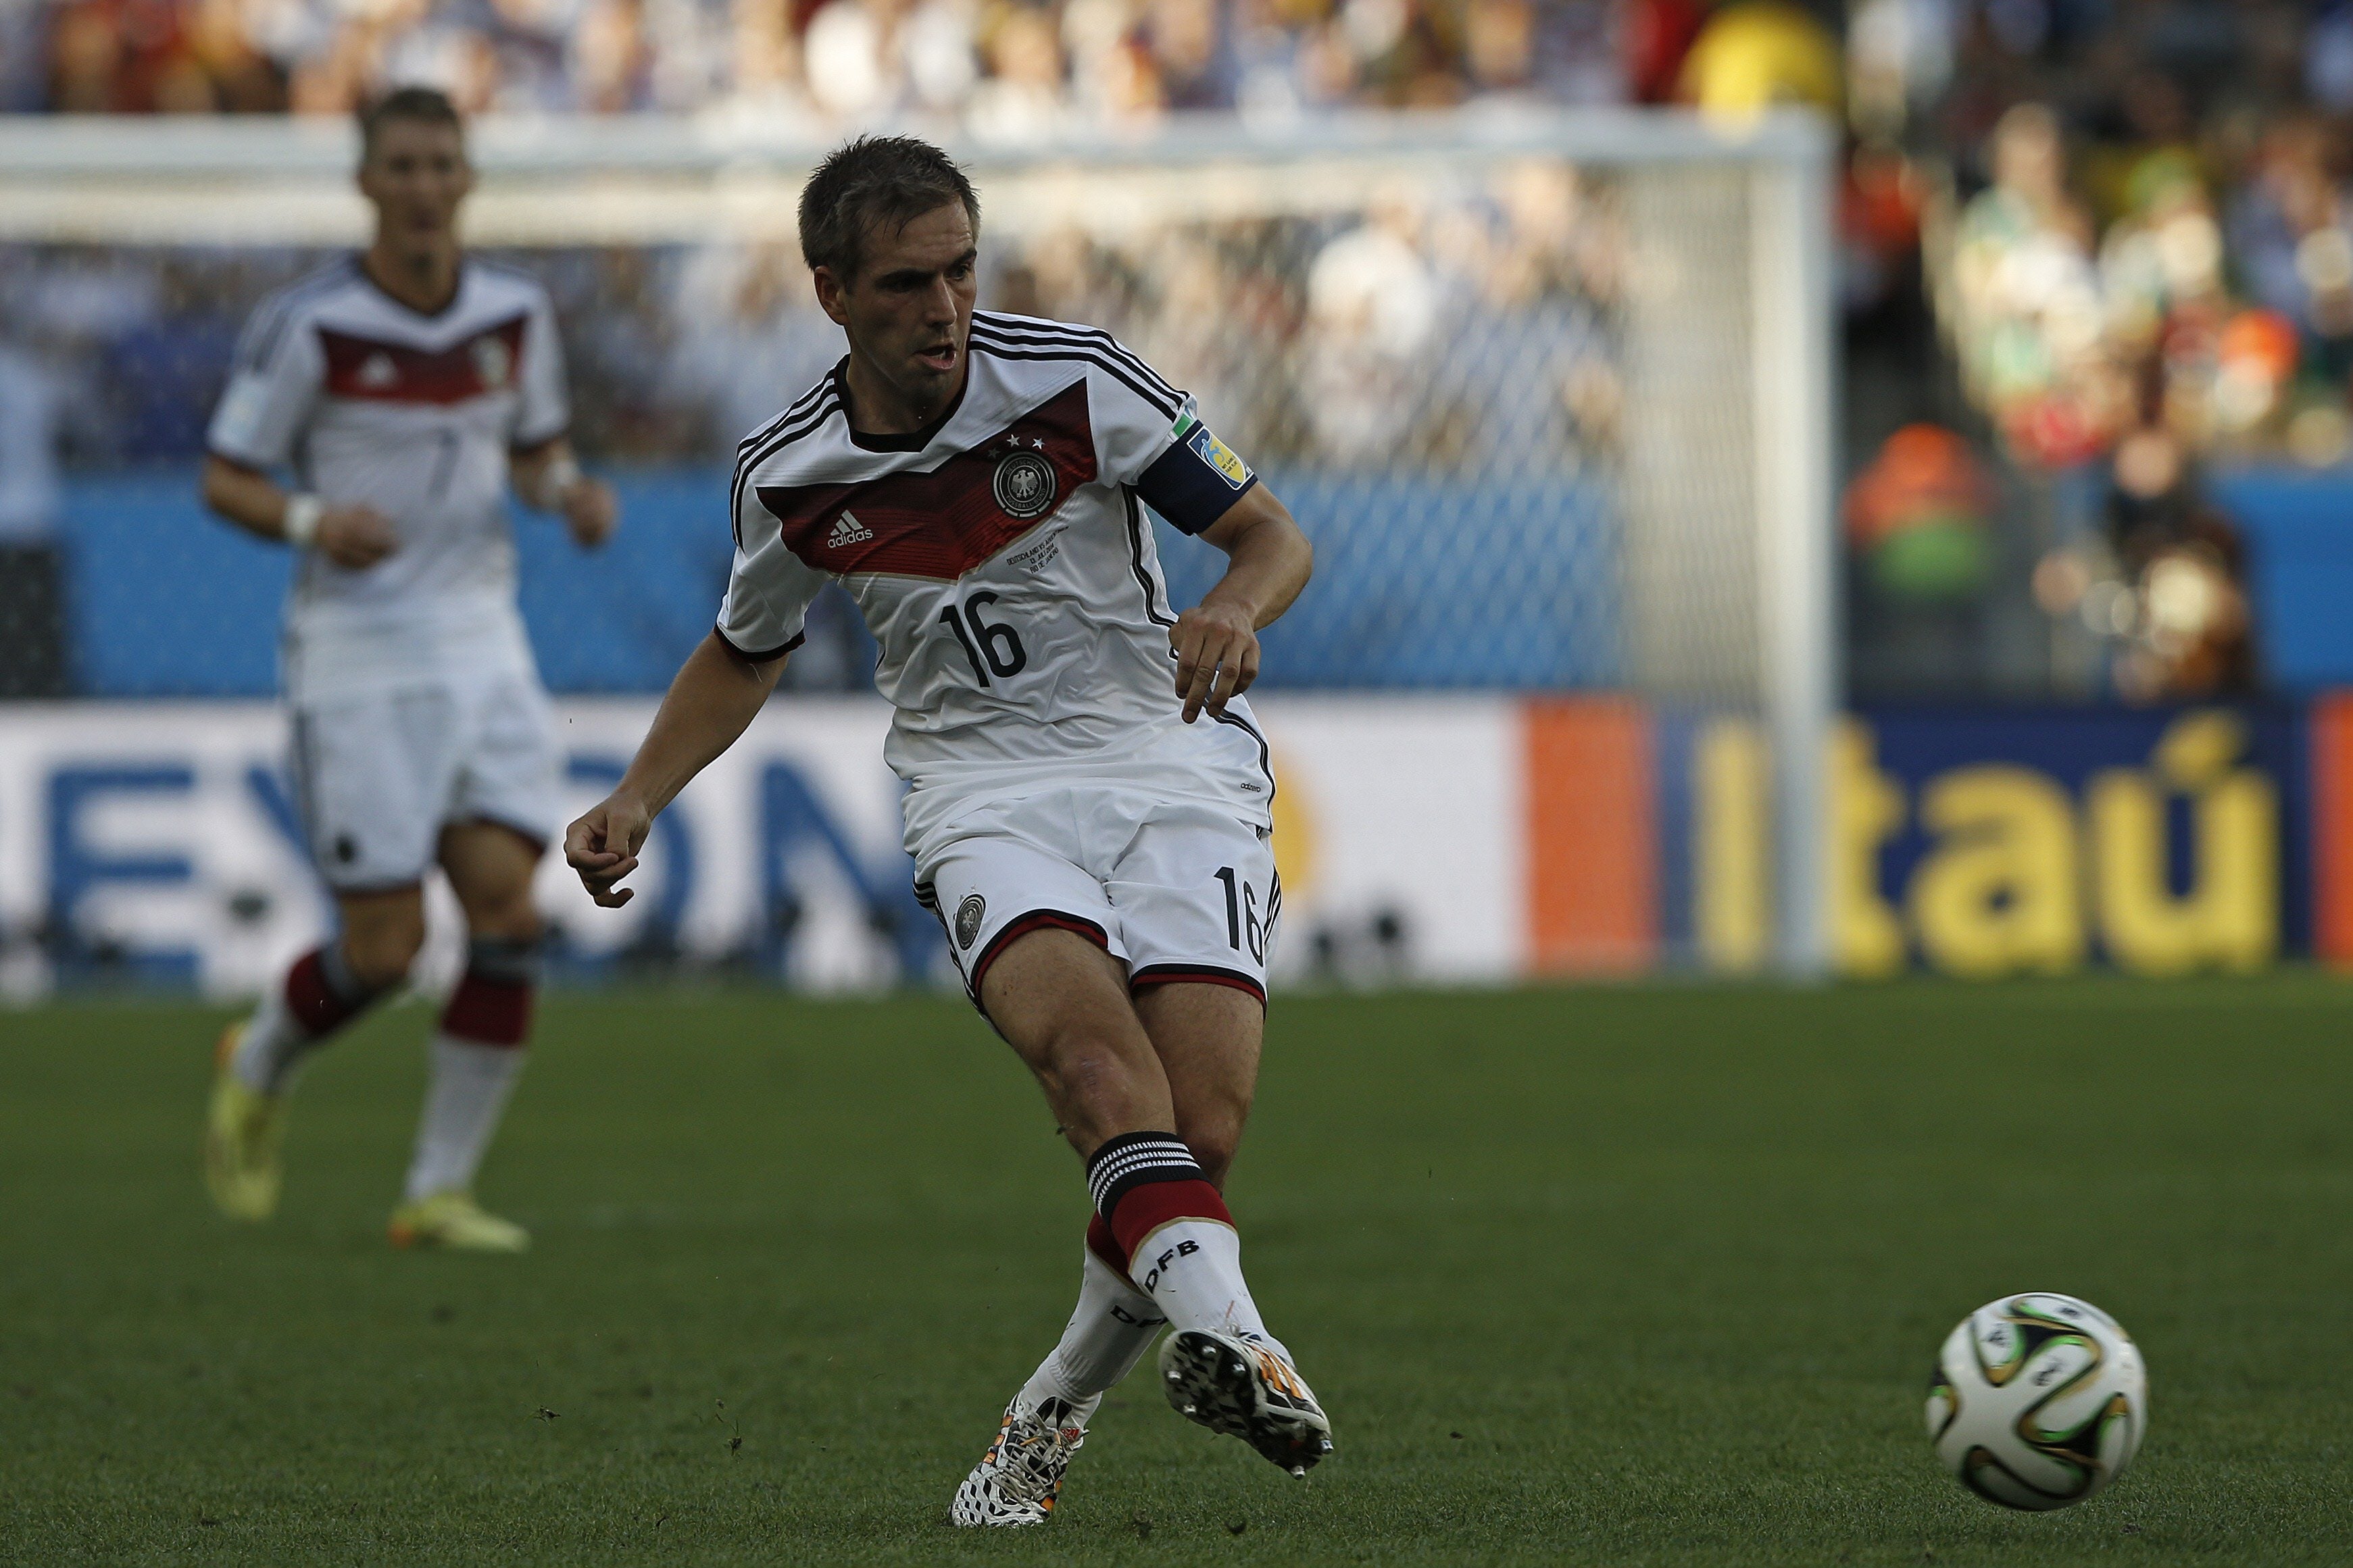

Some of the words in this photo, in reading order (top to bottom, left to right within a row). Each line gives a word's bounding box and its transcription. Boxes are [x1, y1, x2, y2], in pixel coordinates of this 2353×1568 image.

[1006, 459, 1039, 475] DEUTSCHER
[828, 529, 873, 549] adidas
[1006, 546, 1039, 566] DEUTSCHLAND
[1037, 550, 1046, 561] JULI
[1029, 564, 1039, 574] RIO
[1038, 560, 1045, 569] DE
[939, 591, 1026, 688] 16
[1693, 707, 2281, 979] Itaú
[1213, 865, 1264, 967] 16
[1144, 1240, 1200, 1294] DFB
